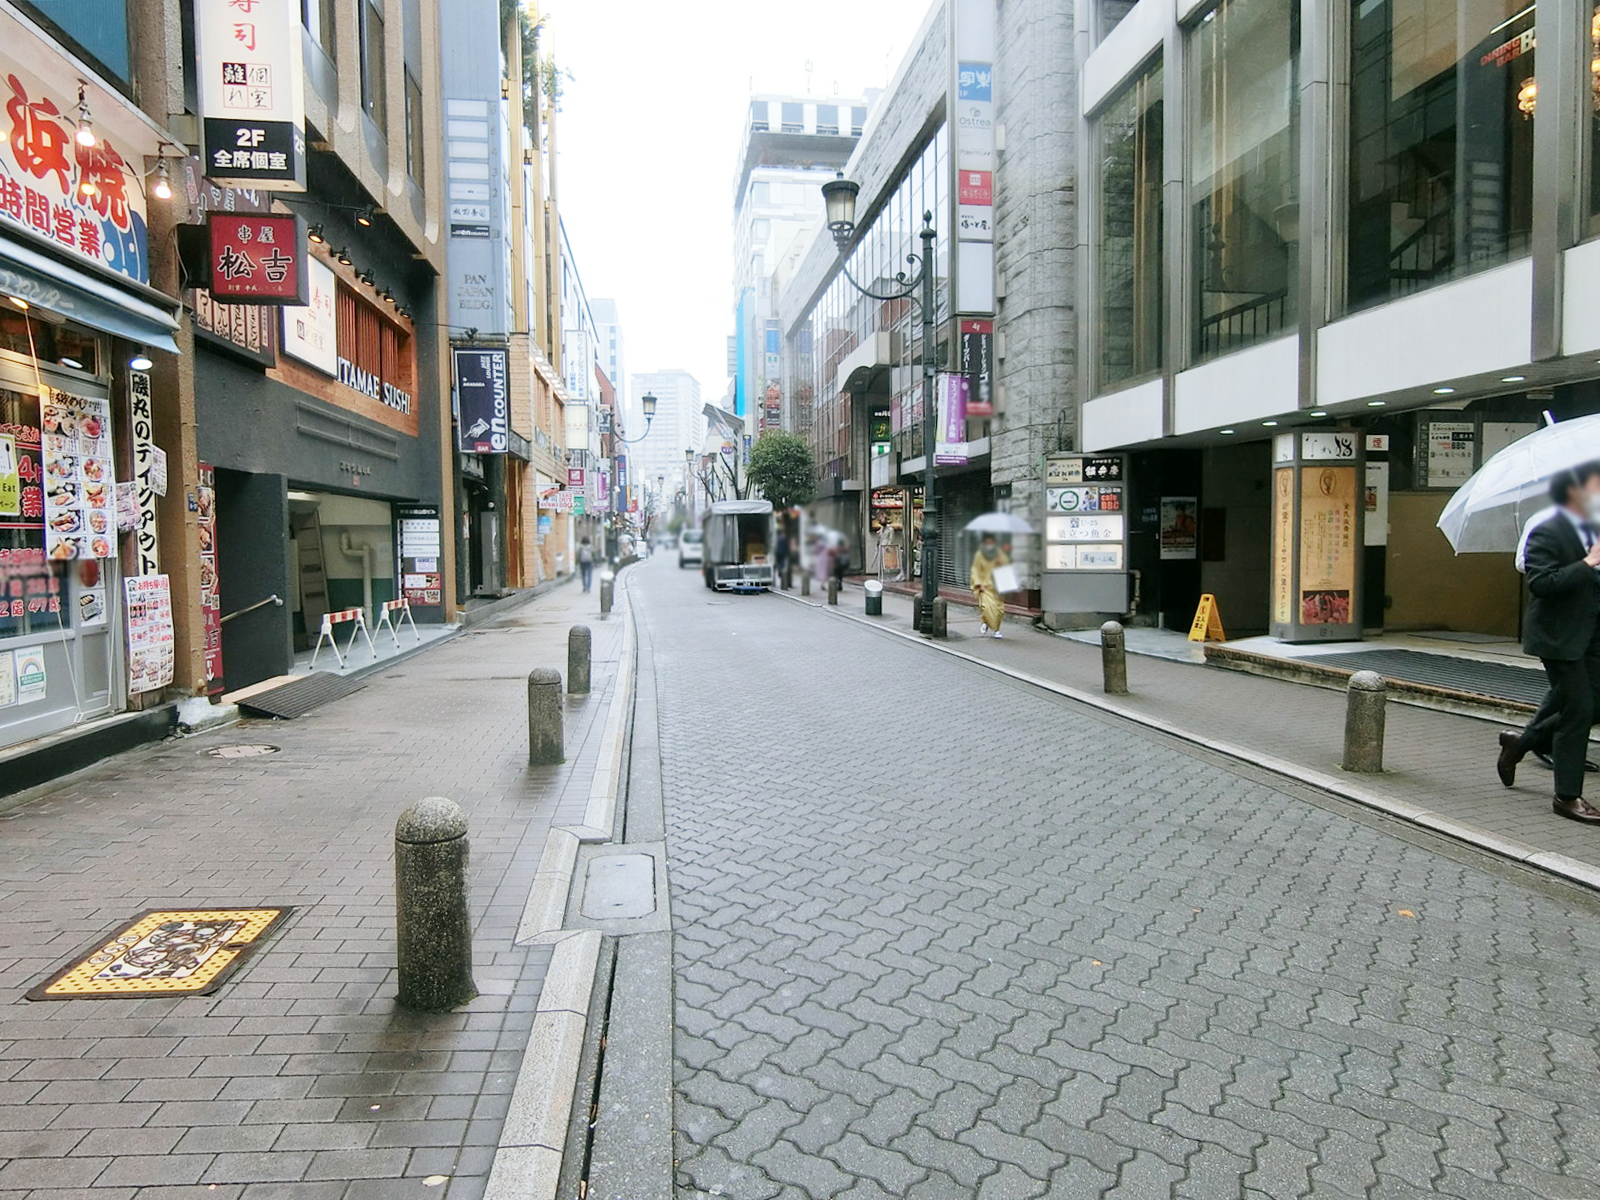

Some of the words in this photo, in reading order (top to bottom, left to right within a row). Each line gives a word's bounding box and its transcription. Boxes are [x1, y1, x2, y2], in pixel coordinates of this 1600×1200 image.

[959, 117, 991, 127] Ostrea
[236, 128, 265, 147] 2F
[213, 150, 288, 171] 全席個室
[237, 224, 275, 245] 串屋
[218, 246, 293, 283] 松吉
[464, 275, 487, 285] PAN
[457, 287, 494, 298] JAPAN
[337, 355, 380, 401] ITAMAE
[383, 381, 411, 415] SUSHI
[2, 482, 16, 493] Eat
[1101, 501, 1119, 510] BBC
